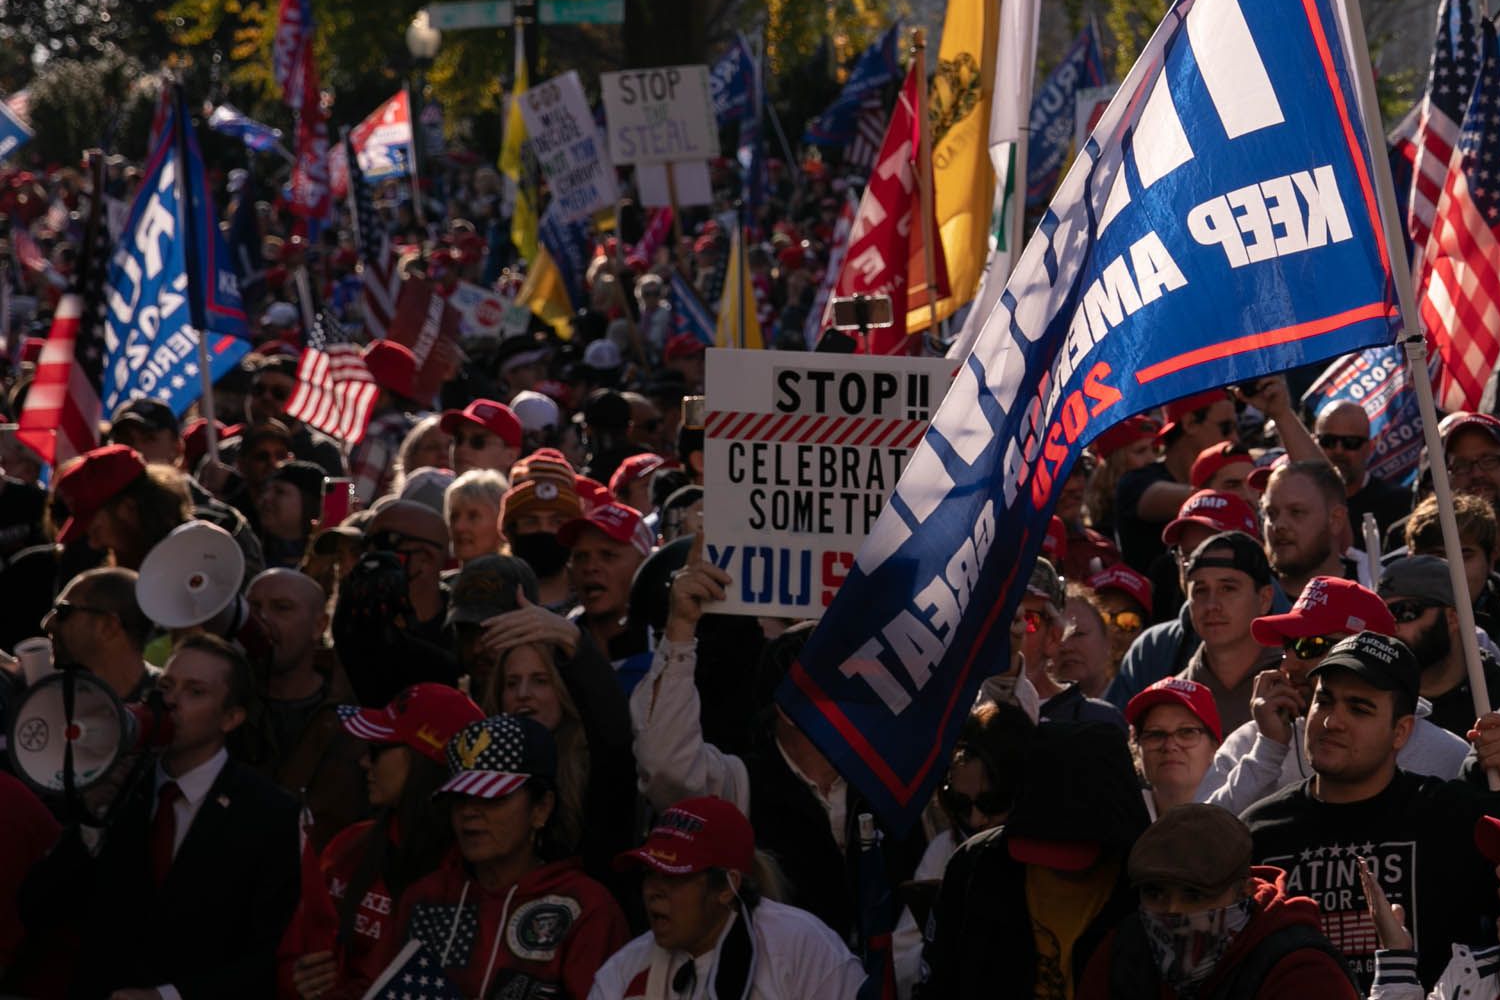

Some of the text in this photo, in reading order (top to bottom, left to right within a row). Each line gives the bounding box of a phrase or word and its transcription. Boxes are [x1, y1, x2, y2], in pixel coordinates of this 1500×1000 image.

[619, 70, 681, 104] STOP
[618, 118, 699, 157] STEAL
[776, 370, 930, 421] STOP!!
[1286, 852, 1404, 892] ATINOS
